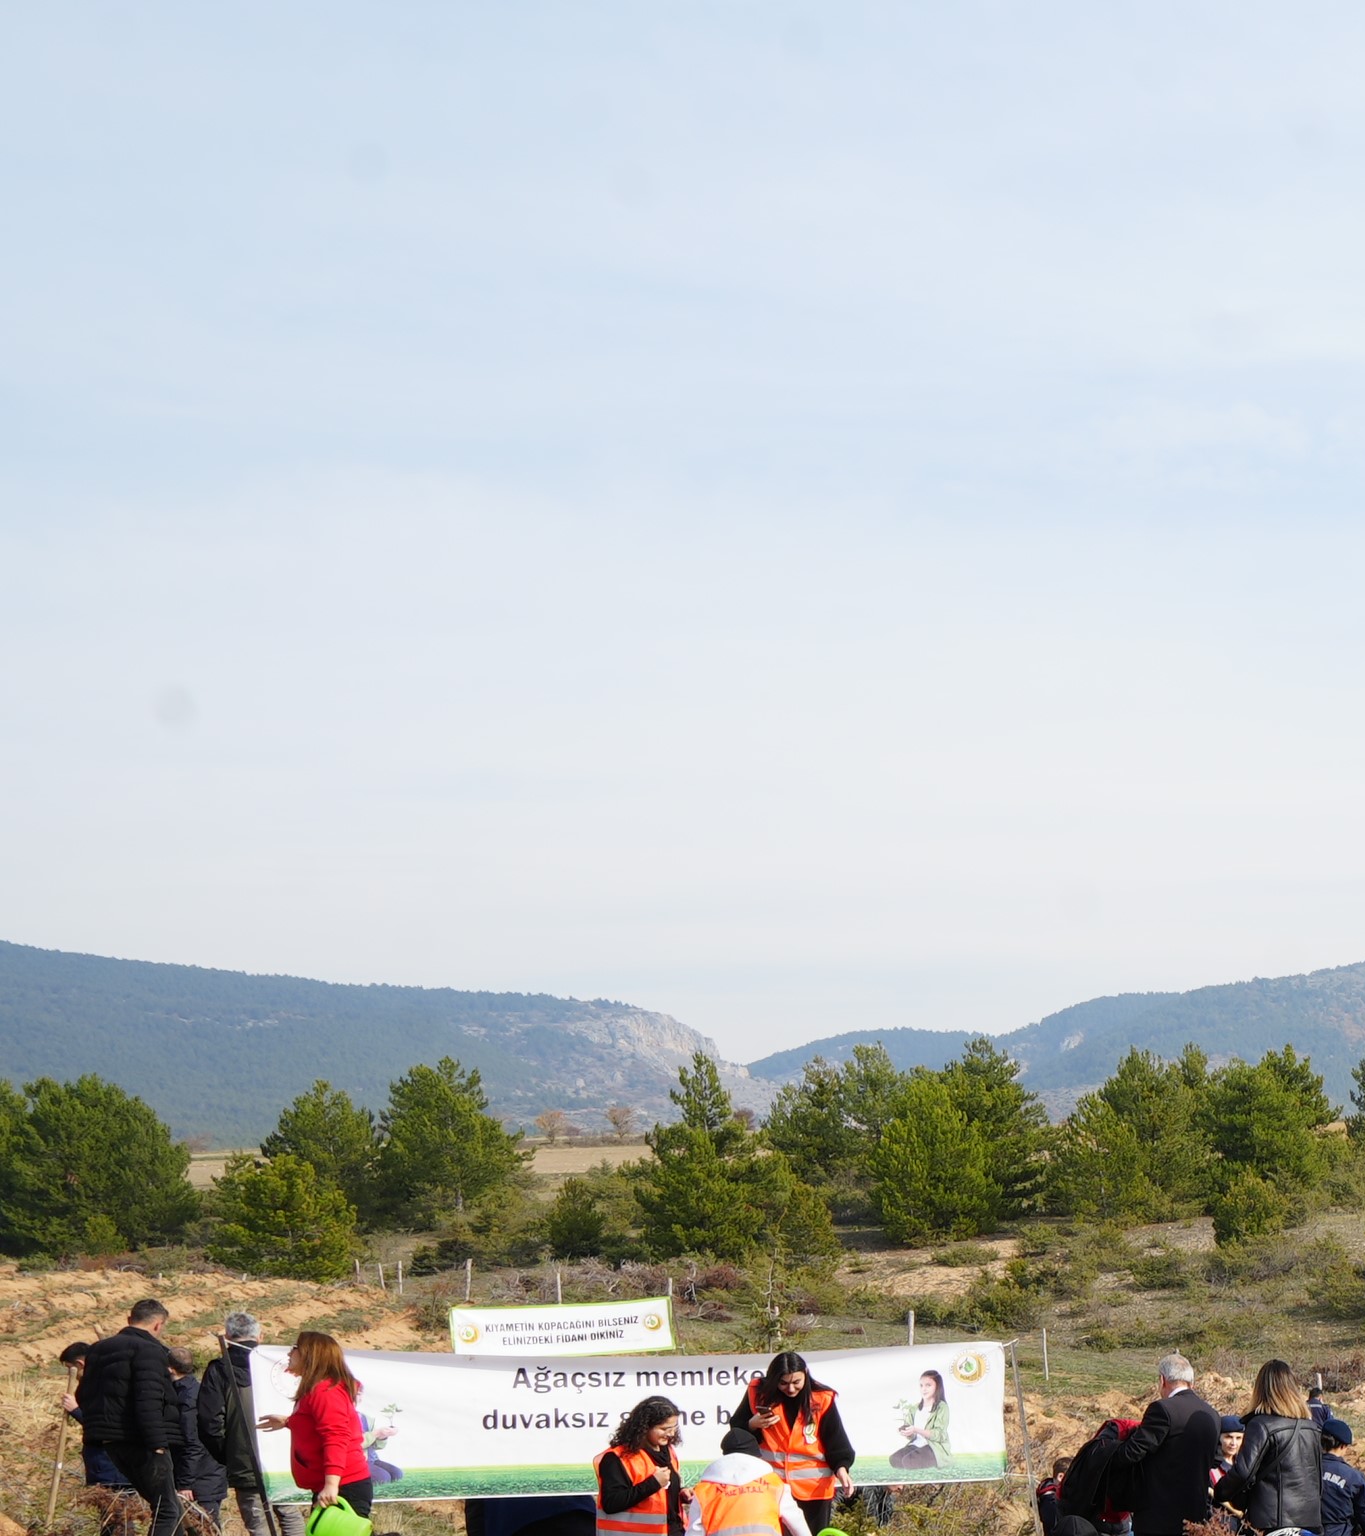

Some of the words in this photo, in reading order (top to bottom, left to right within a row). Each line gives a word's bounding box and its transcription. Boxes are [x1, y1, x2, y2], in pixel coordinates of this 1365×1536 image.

[598, 1315, 639, 1328] BİLSENİZ
[502, 1333, 553, 1346] ELİNİZDEKİ
[556, 1333, 588, 1344] FİDANI
[590, 1329, 625, 1341] DİKİNİZ
[512, 1366, 626, 1395] Ağaçsız
[482, 1408, 609, 1430] duvaksız
